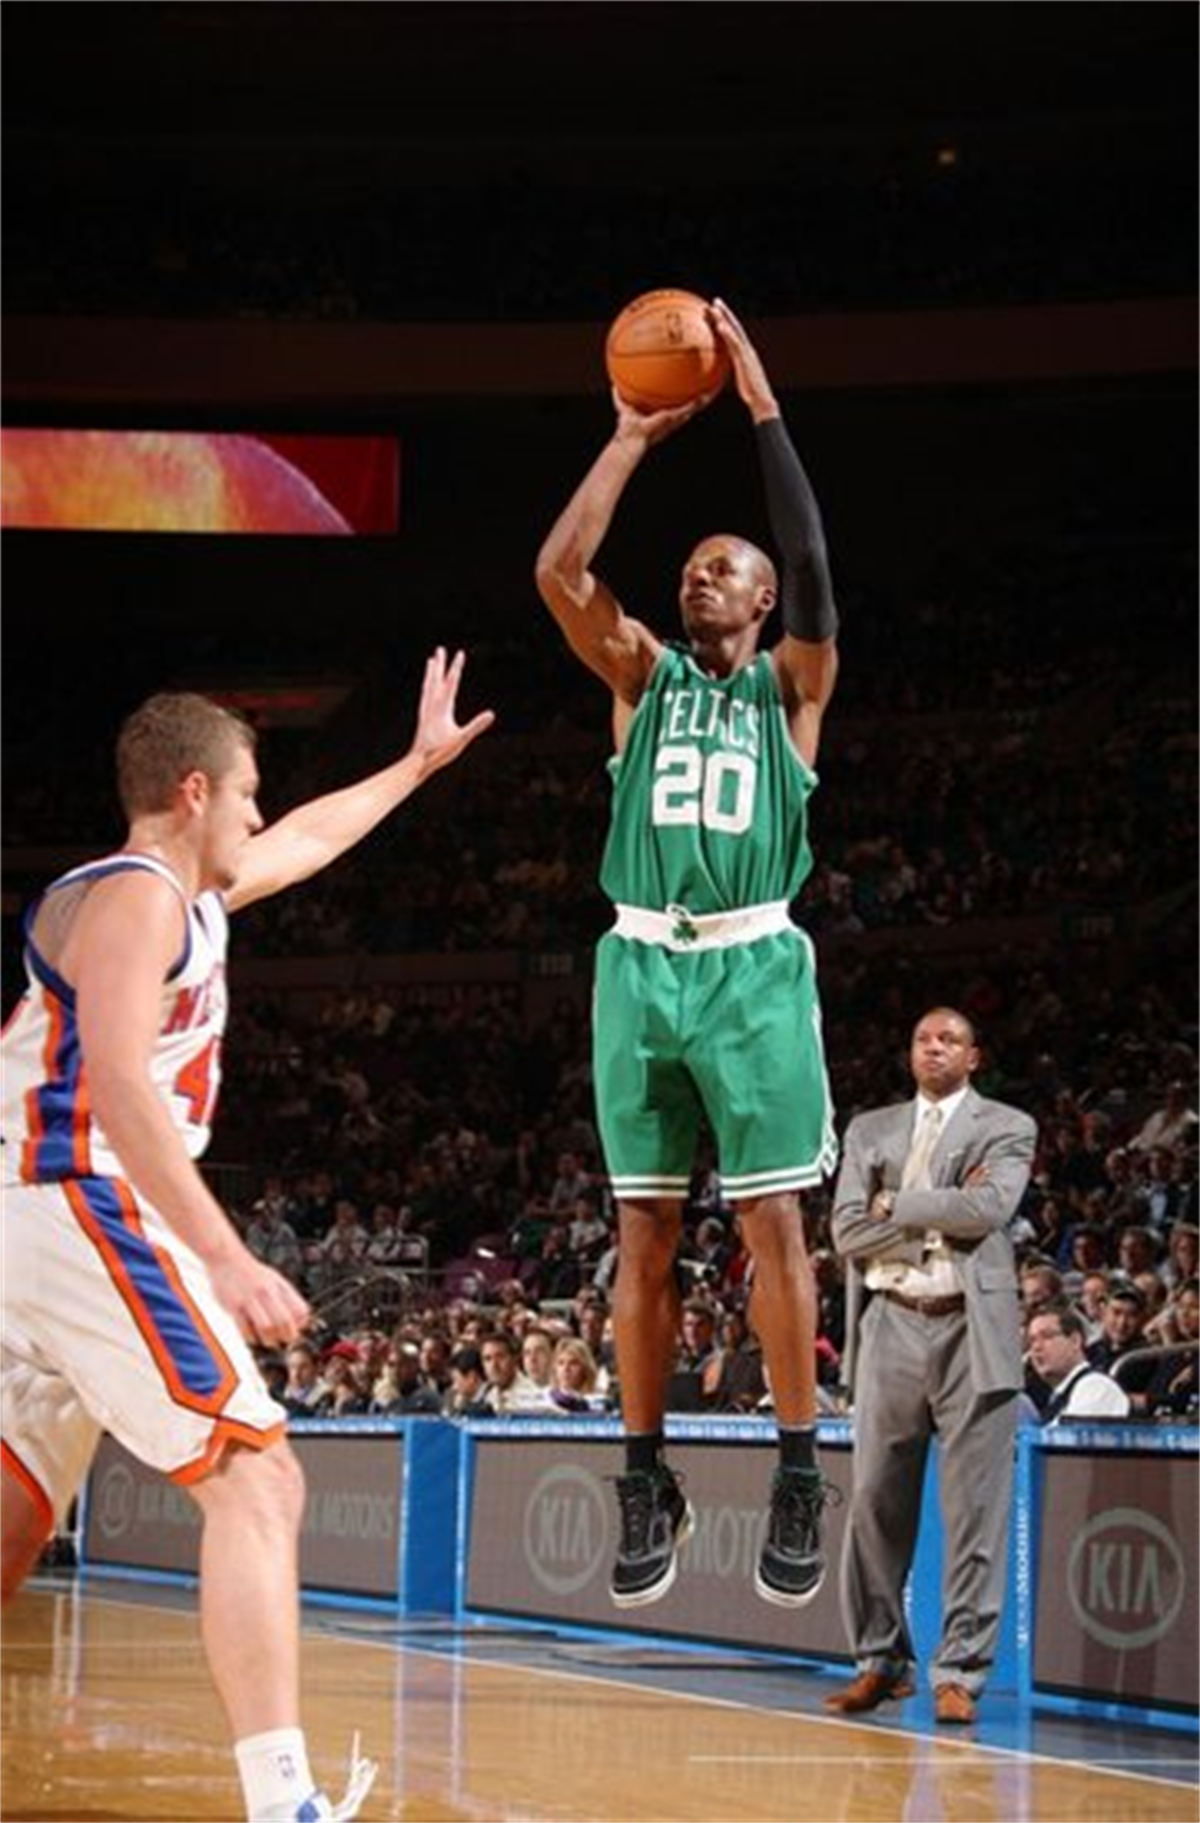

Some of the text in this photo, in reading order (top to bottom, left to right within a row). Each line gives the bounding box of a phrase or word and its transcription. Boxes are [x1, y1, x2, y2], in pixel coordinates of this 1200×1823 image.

[652, 744, 758, 835] 20
[538, 1496, 768, 1577] KIA MOT
[1087, 1541, 1163, 1615] KIA
